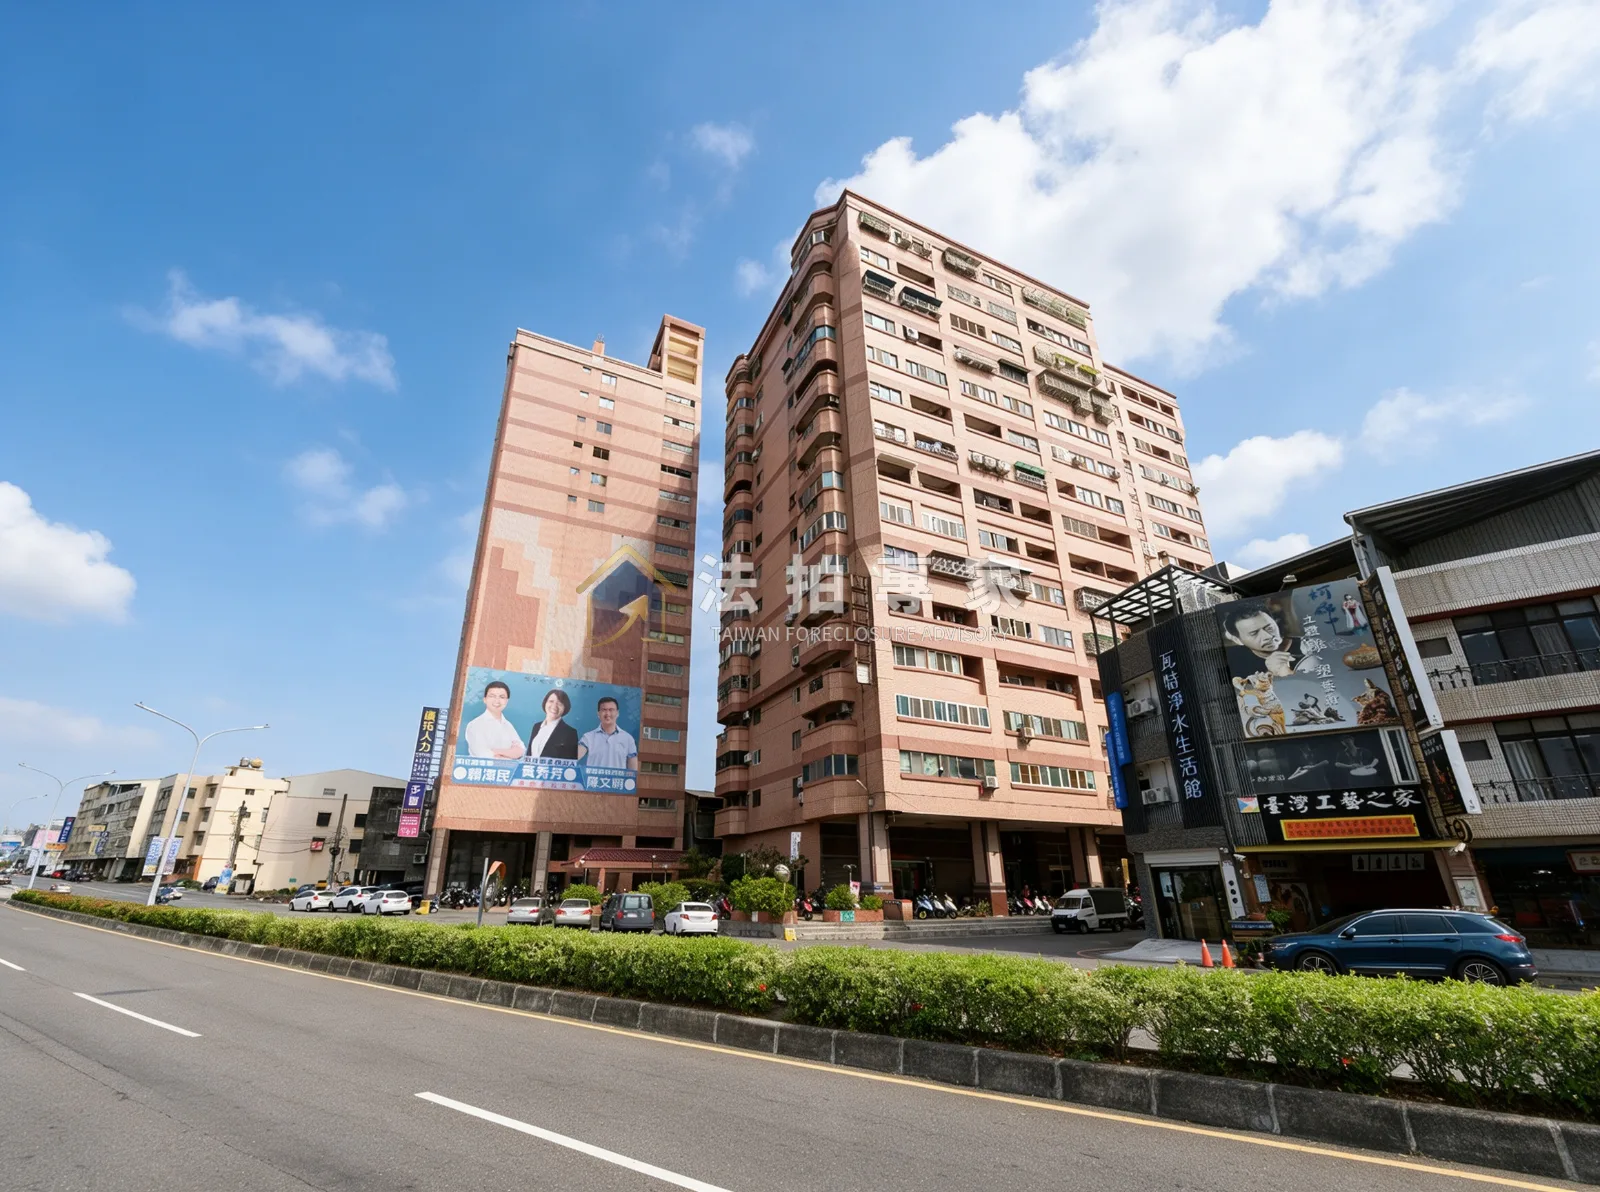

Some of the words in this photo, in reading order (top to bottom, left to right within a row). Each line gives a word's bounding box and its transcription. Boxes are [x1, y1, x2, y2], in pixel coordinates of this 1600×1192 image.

[1263, 788, 1422, 815] 臺灣工藝之家
